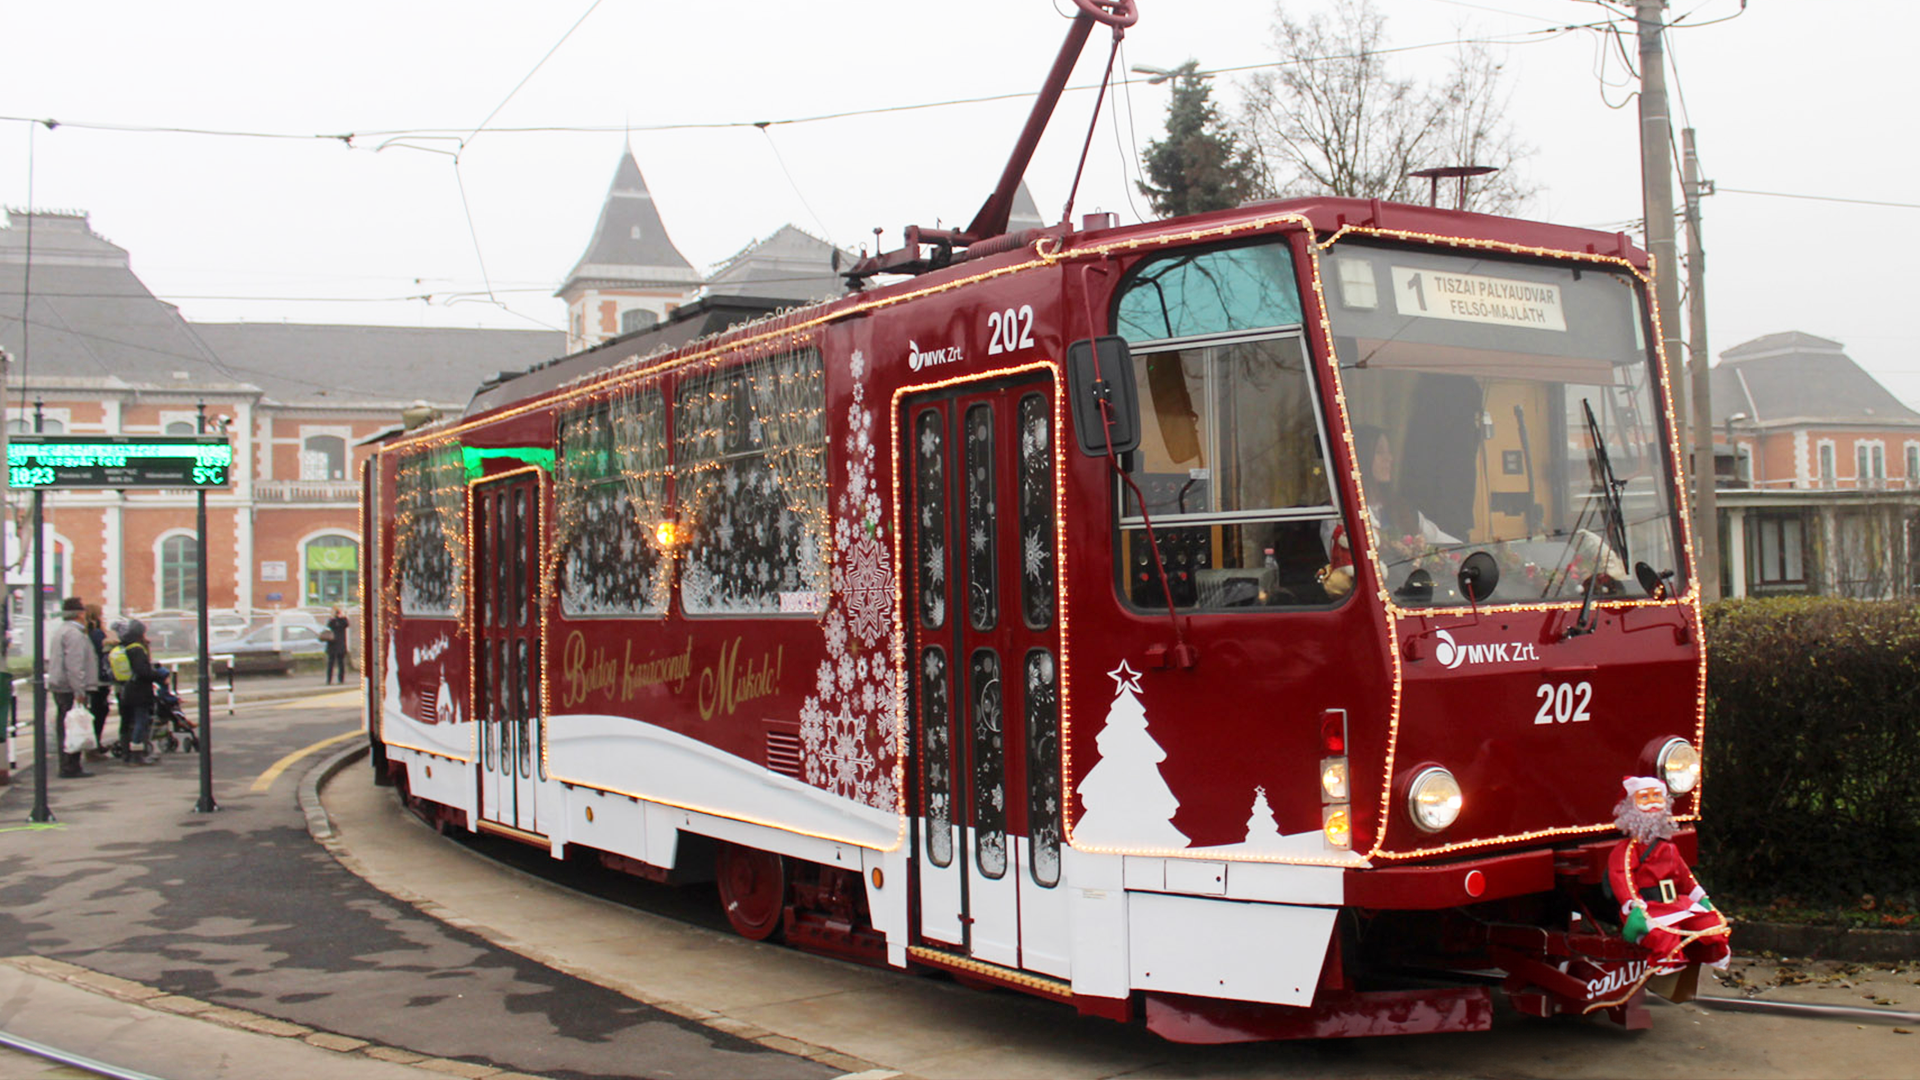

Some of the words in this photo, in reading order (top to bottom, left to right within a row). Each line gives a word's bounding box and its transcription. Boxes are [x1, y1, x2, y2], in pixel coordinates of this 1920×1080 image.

[1406, 272, 1428, 312] 1
[1434, 276, 1476, 296] TISZAI
[1479, 278, 1555, 305] PÁLYAUDVAR
[987, 304, 1035, 356] 202
[924, 348, 946, 367] MVK
[947, 346, 964, 362] Zrt.
[1467, 643, 1510, 664] MVK
[1510, 642, 1540, 661] Zrt.
[563, 630, 617, 709] Boldog
[699, 636, 783, 721] Miskolc!
[1534, 681, 1593, 725] 202
